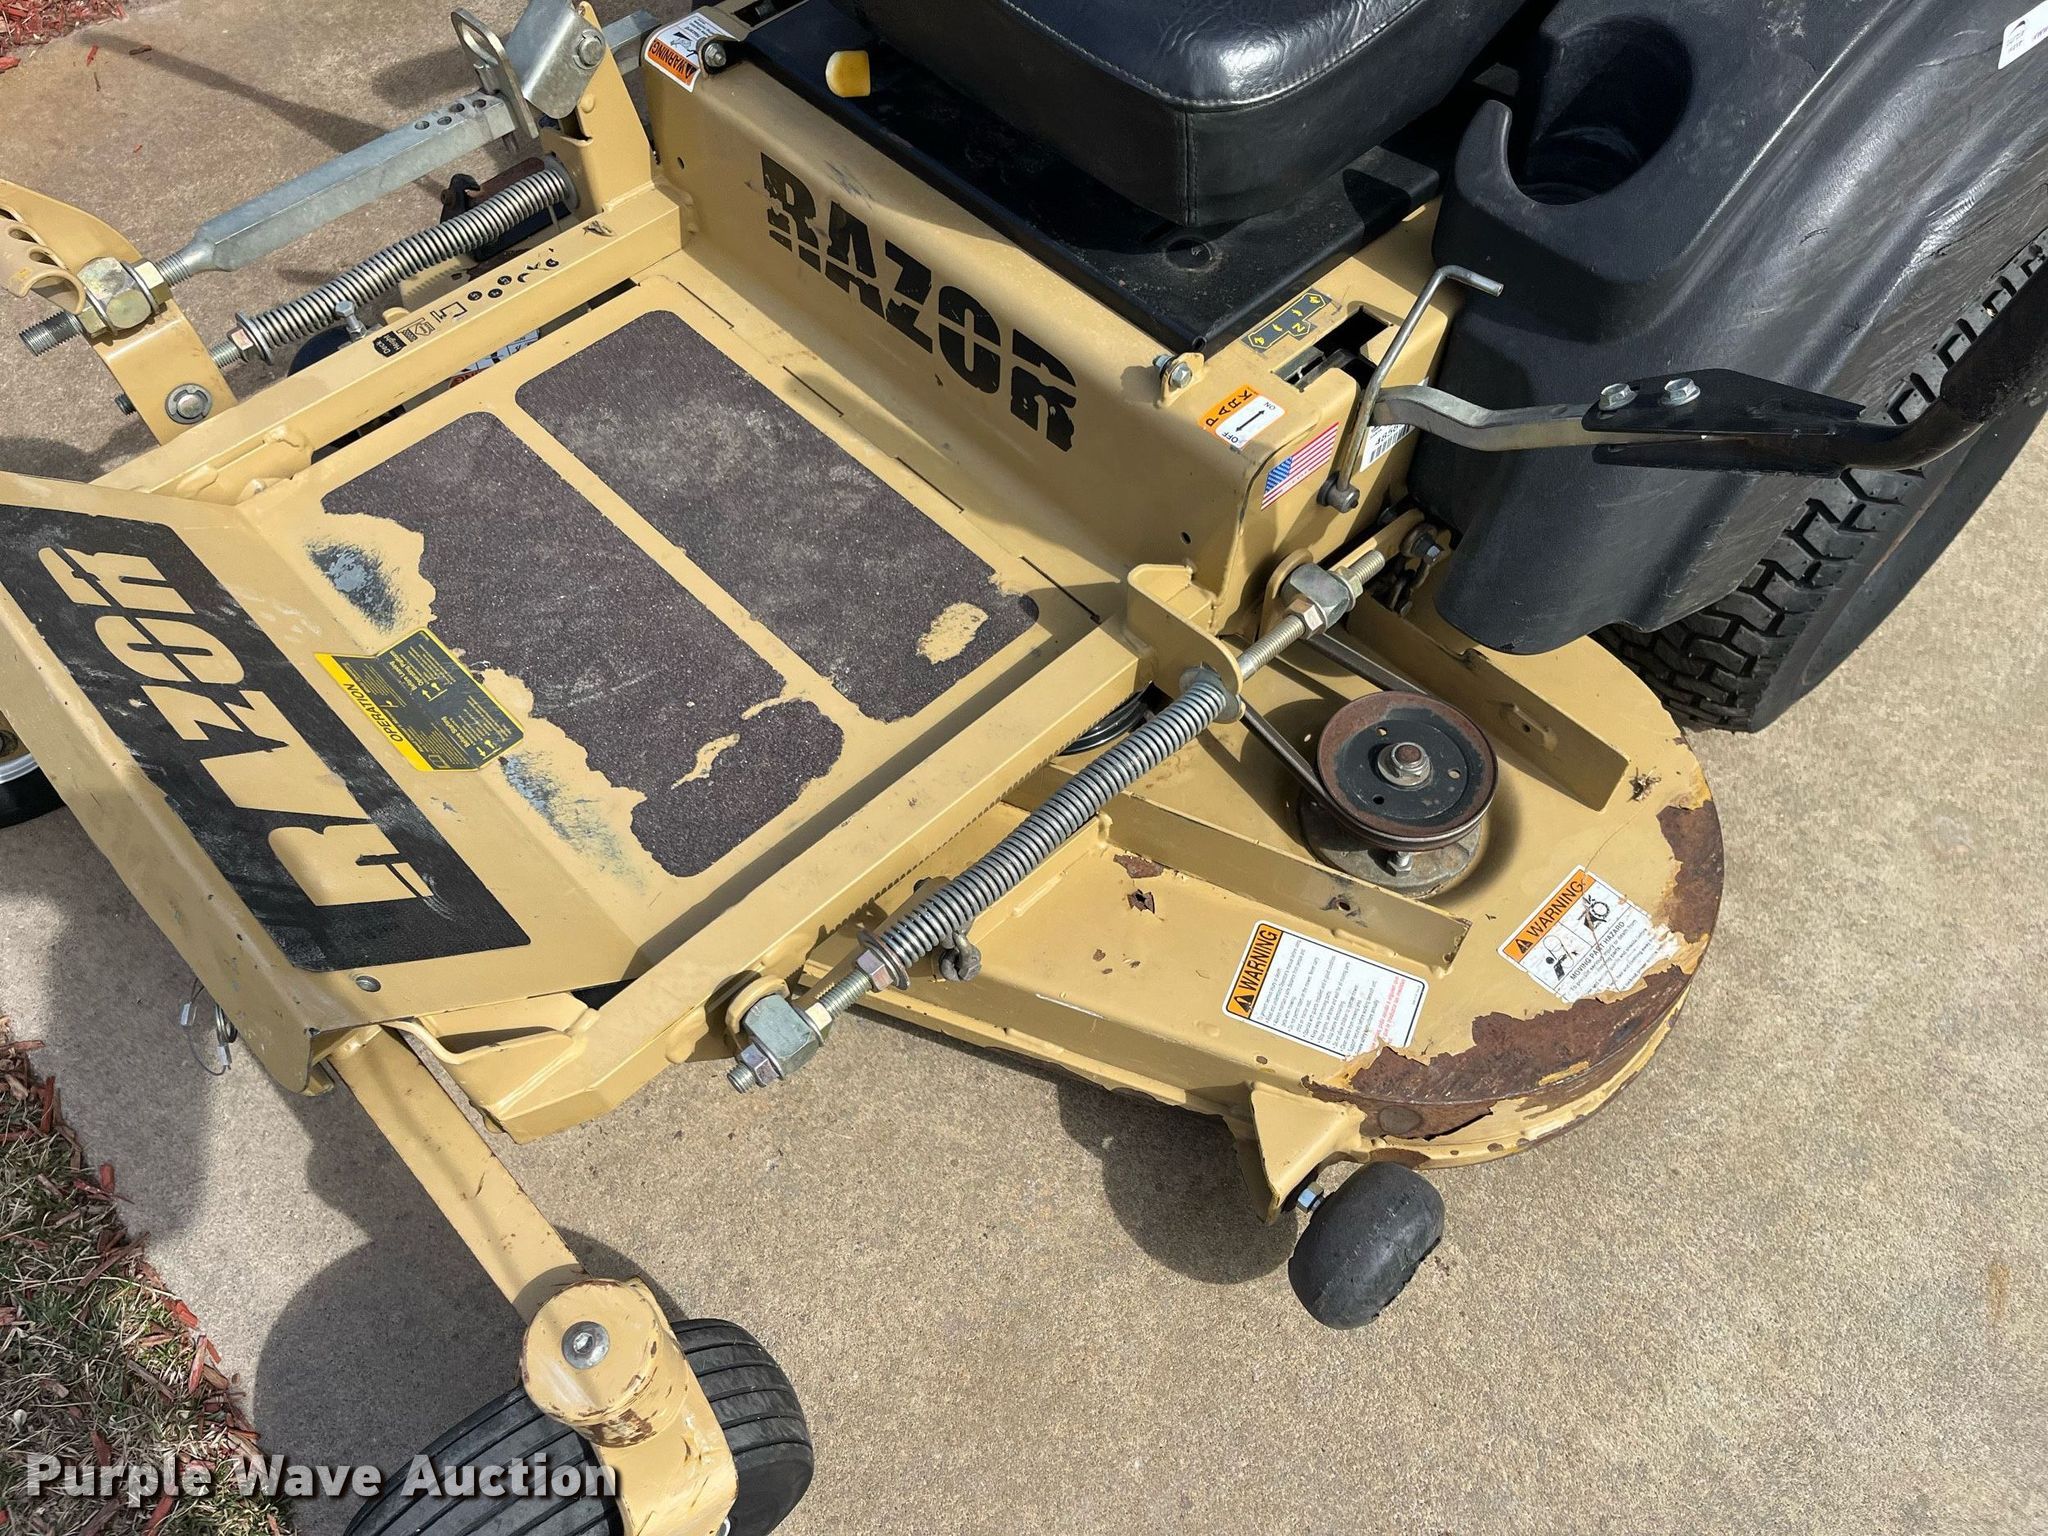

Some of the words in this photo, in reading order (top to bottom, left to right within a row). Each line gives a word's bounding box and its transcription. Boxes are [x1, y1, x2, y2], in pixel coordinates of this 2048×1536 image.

[651, 41, 687, 74] WARNING
[760, 152, 1077, 452] RAZOR
[1205, 389, 1253, 428] PARK
[1263, 401, 1276, 412] ON
[1221, 431, 1239, 444] OFF
[38, 547, 434, 907] RAZOR
[344, 683, 403, 742] OPERATION
[1527, 881, 1584, 937] WARNING
[1239, 928, 1277, 992] WARNING
[1568, 957, 1592, 980] MOVING
[1588, 942, 1605, 958] PART
[1602, 920, 1625, 944] HAZARD
